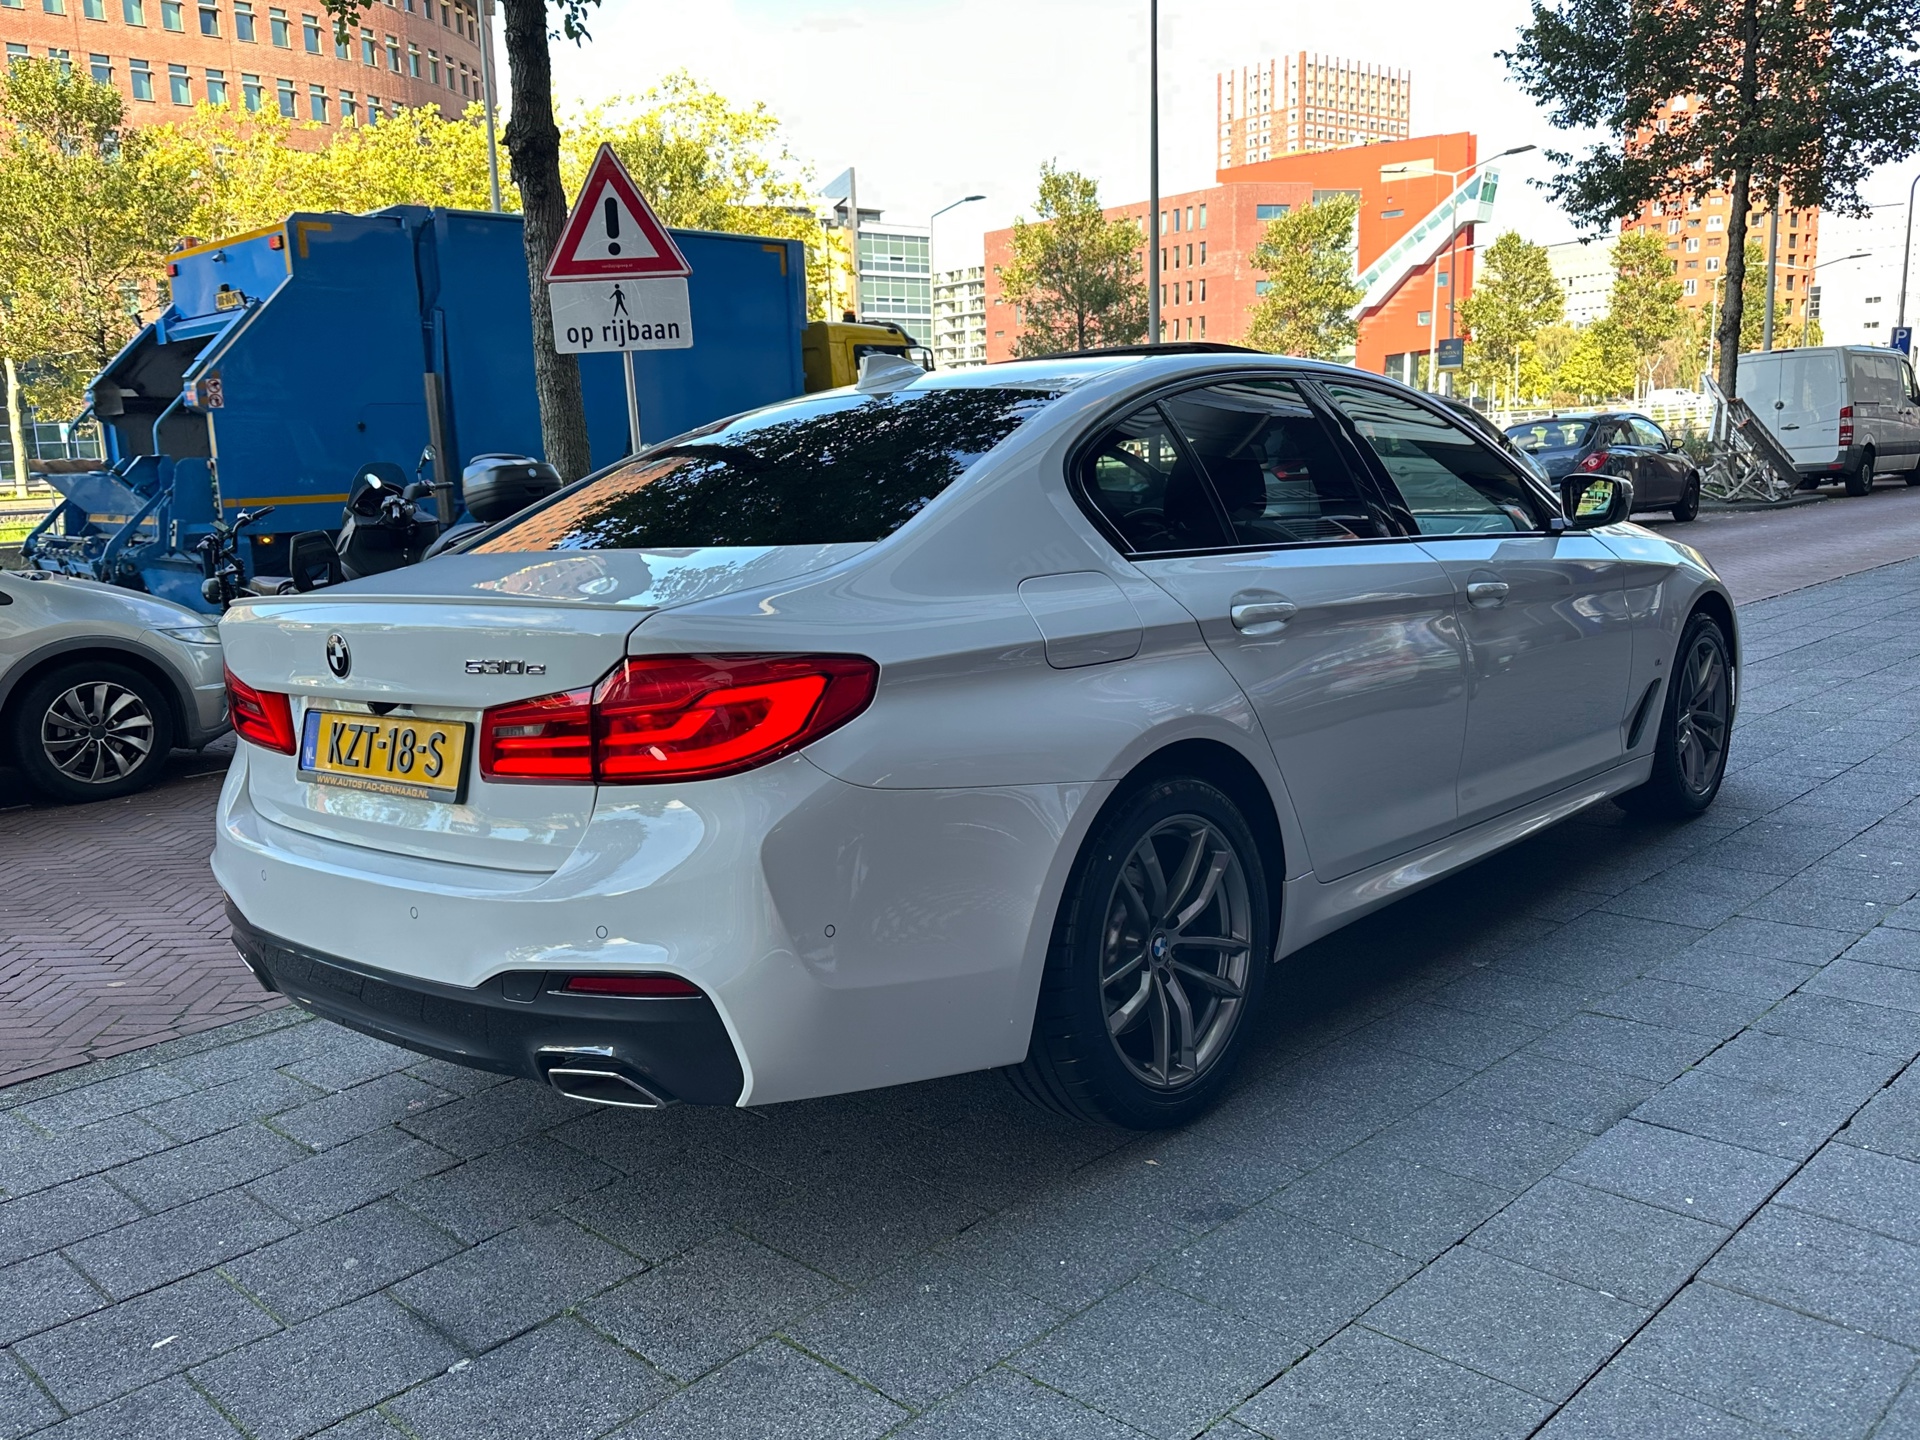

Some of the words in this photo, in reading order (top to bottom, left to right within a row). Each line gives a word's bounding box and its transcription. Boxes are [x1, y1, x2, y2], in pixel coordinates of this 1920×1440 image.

[566, 326, 594, 348] op
[602, 319, 680, 347] rijbaan
[1895, 329, 1907, 344] P
[465, 659, 546, 675] 530e
[327, 721, 446, 778] KZT-18-S
[316, 774, 430, 799] WWW.AUTOSTAD-DENHAAG.NL
